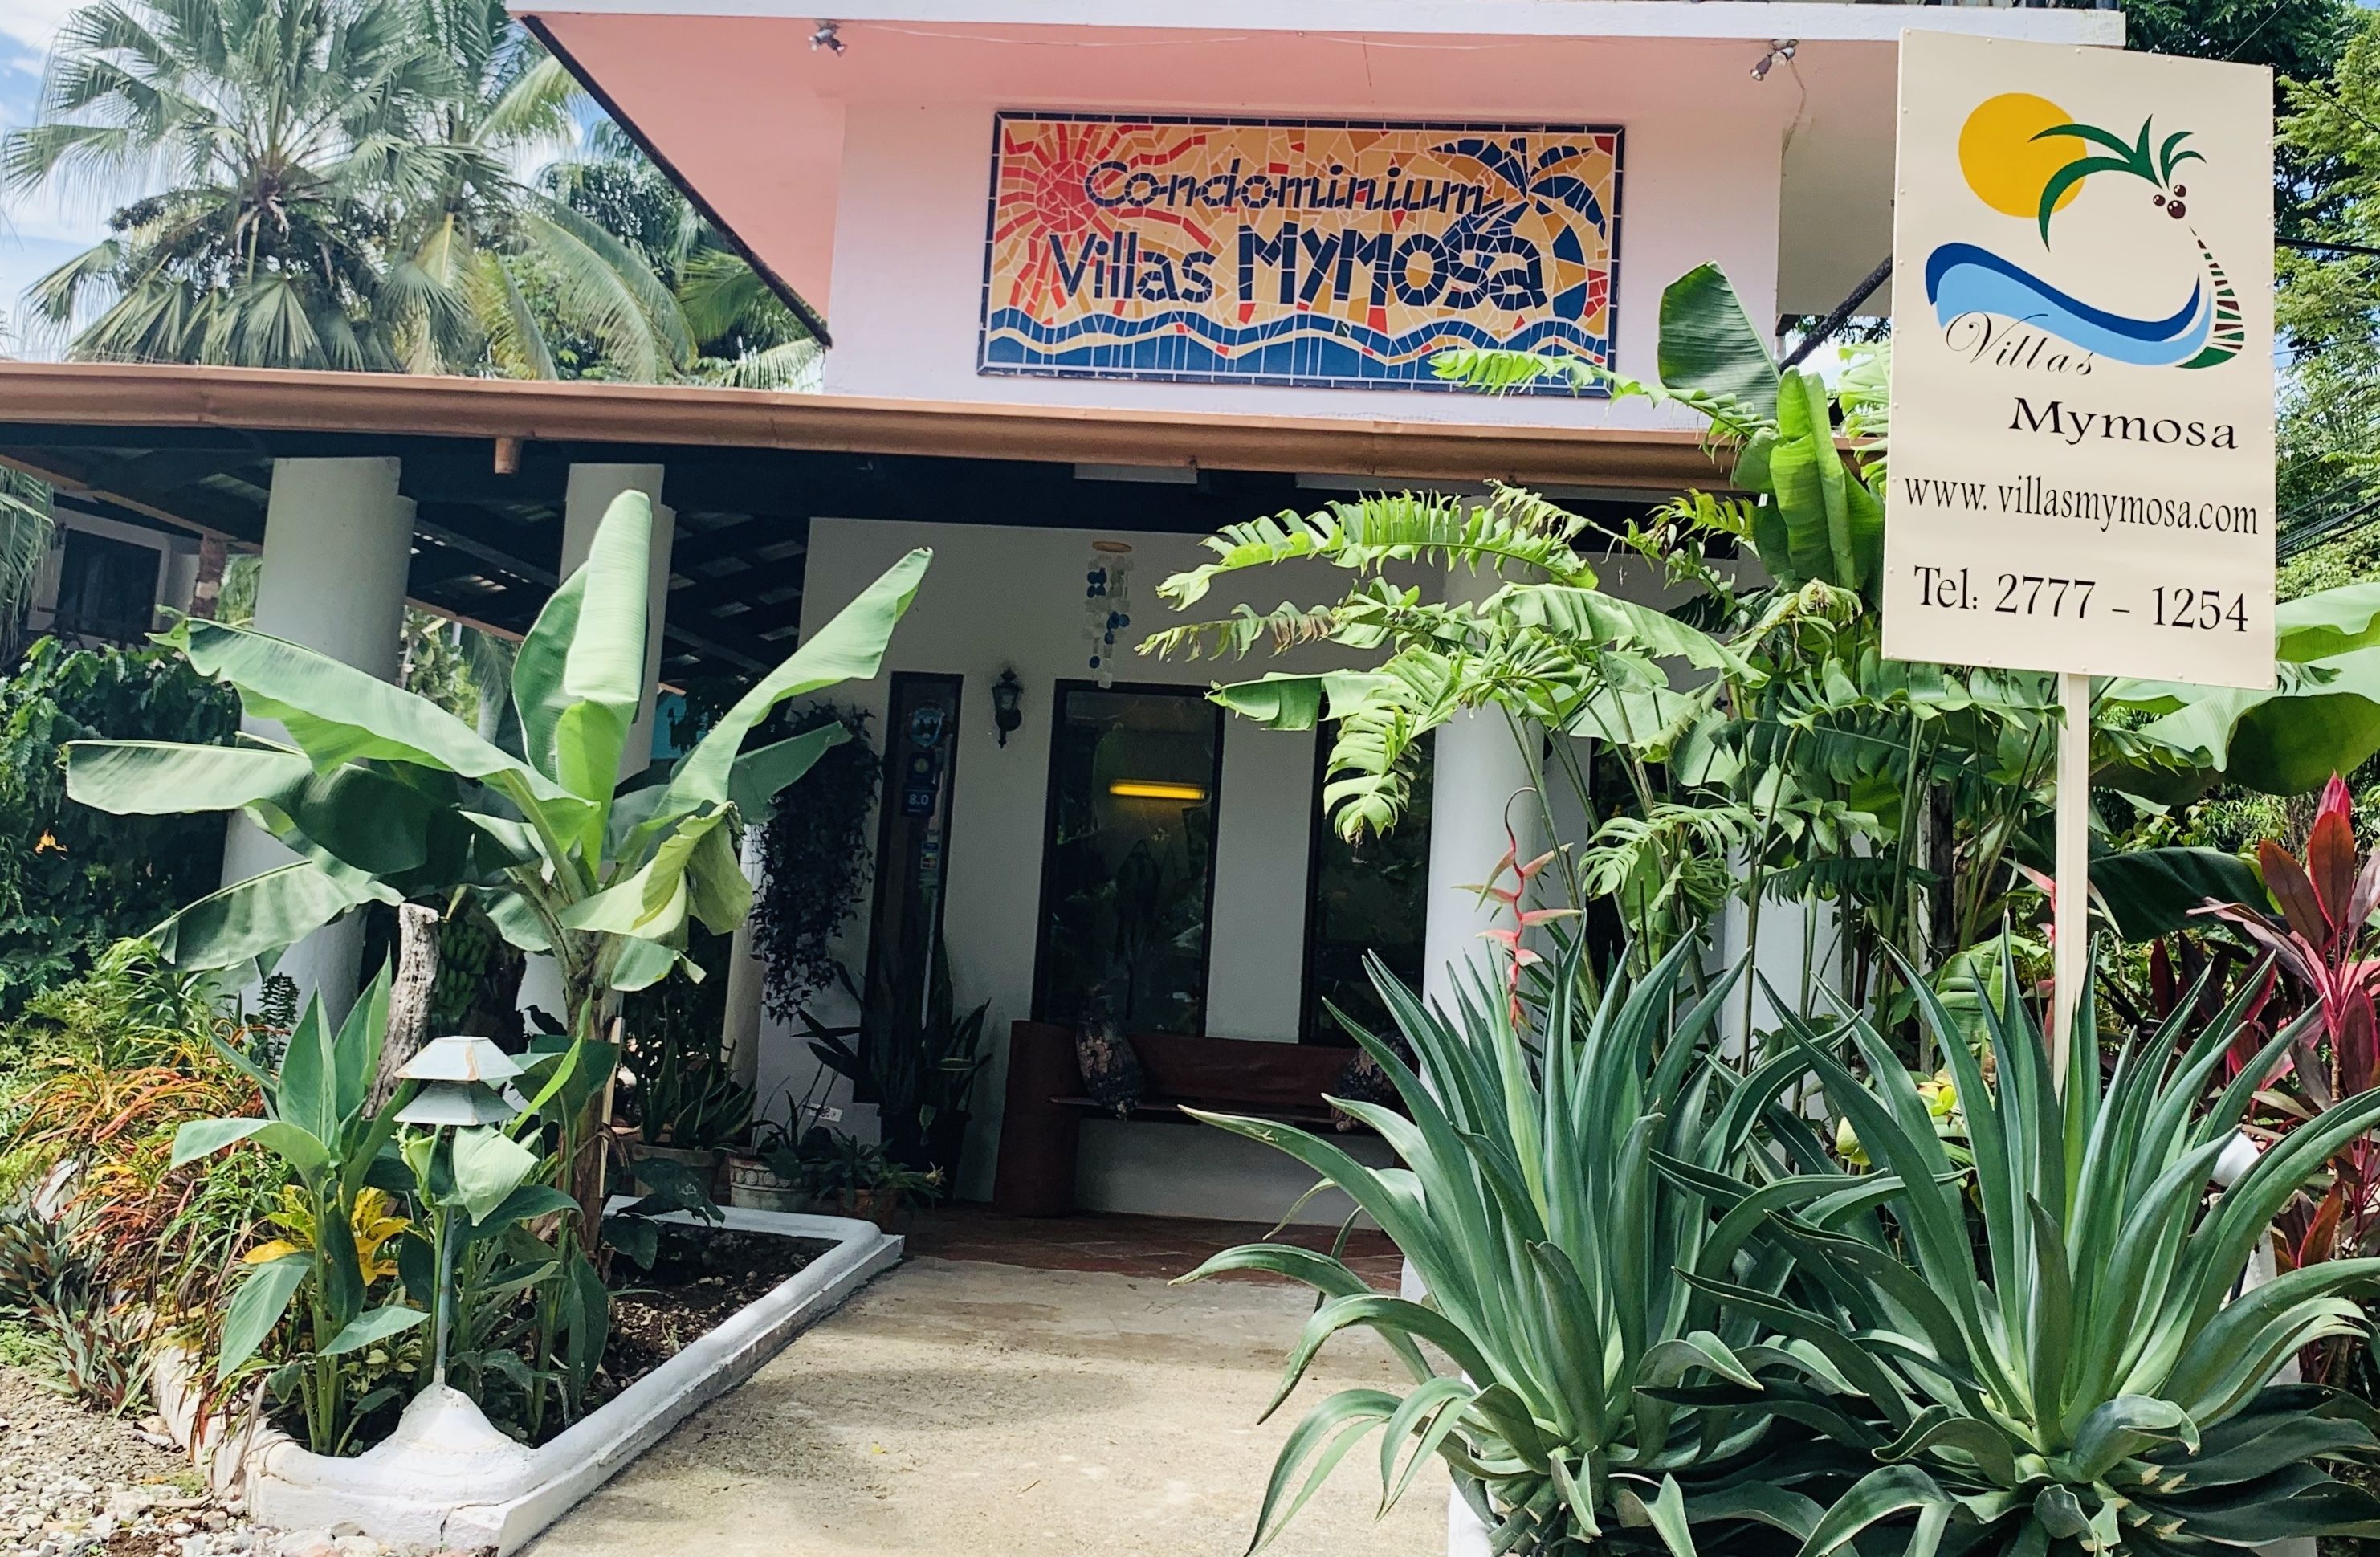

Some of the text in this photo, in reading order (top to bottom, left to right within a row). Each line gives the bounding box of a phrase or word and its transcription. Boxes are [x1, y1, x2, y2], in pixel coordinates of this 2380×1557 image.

[1084, 157, 1502, 215] Condominium
[1049, 230, 1216, 304] Villas
[1945, 310, 2095, 376] Villas
[2007, 397, 2239, 450] Mymosa
[1903, 475, 2259, 536] www. villasmymosa.com
[1913, 565, 1979, 611] Tel:
[1994, 573, 2097, 618] 2777
[2152, 585, 2249, 633] 1254
